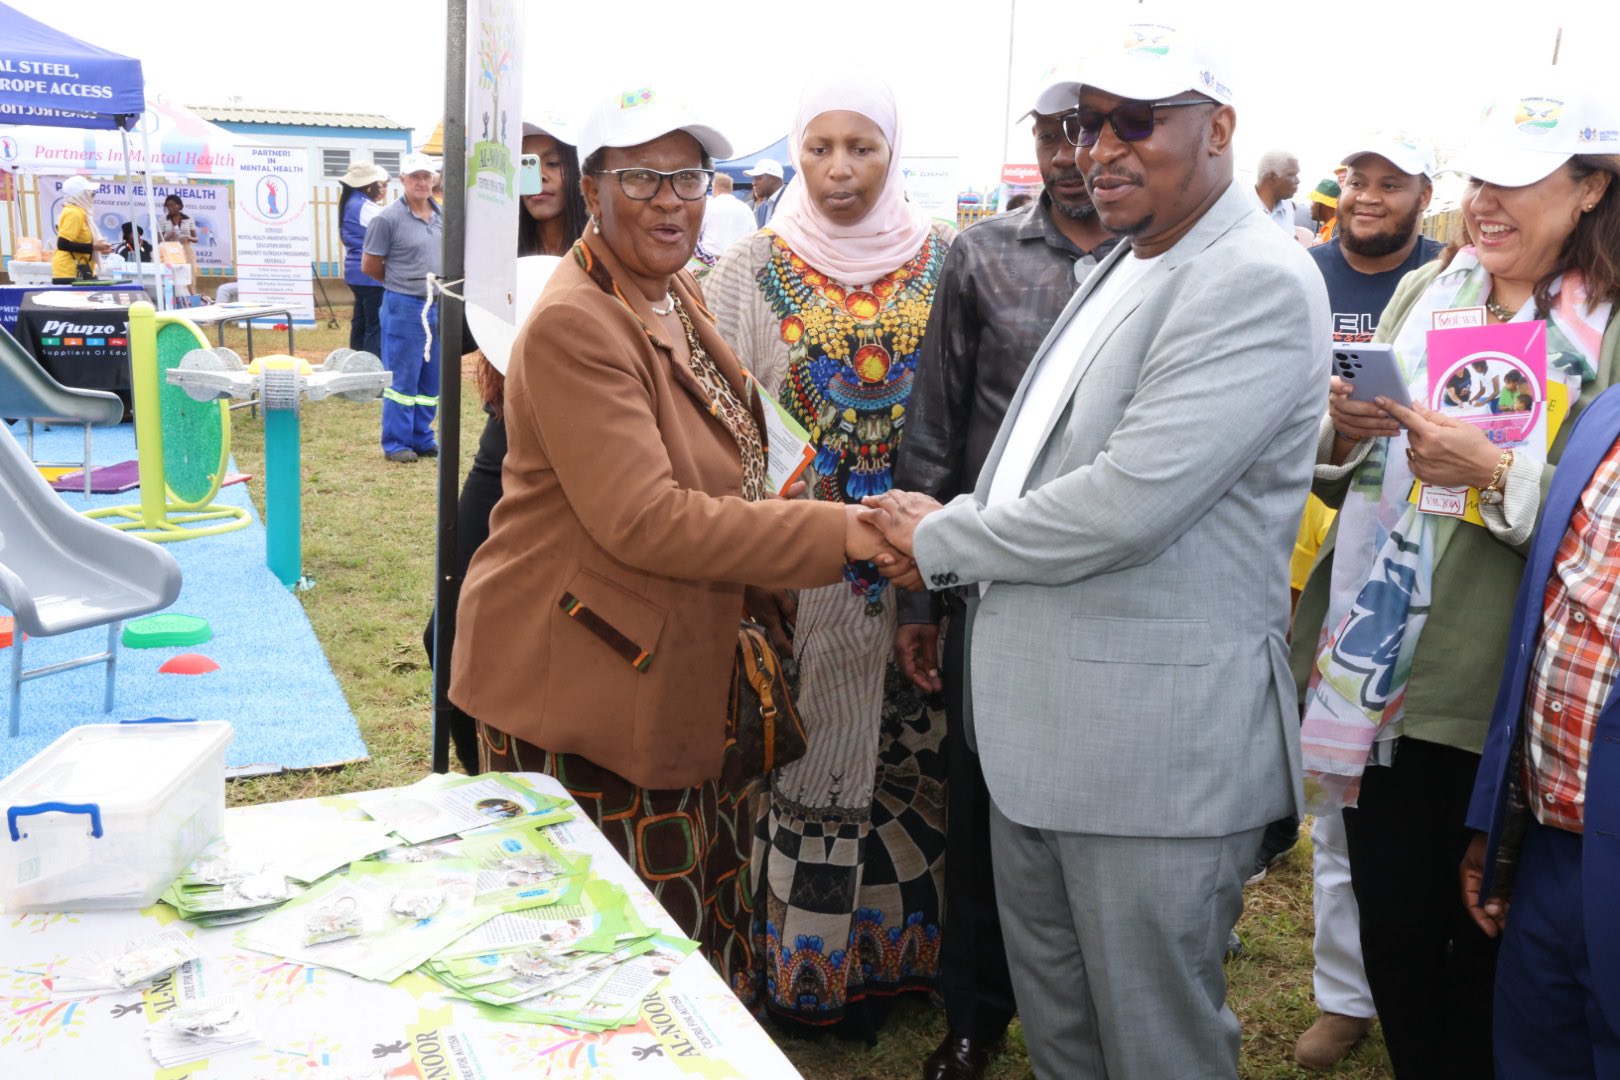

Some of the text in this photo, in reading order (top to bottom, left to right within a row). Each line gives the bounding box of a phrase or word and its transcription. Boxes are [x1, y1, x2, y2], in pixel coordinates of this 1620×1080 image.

[19, 60, 80, 79] STEEL,
[0, 79, 113, 98] ROPE ACCESS
[35, 145, 234, 167] Partners In Mntal Health
[252, 149, 291, 157] PARTNERS
[114, 185, 126, 195] IN
[174, 188, 216, 199] HEALTH
[42, 320, 115, 335] Pfunzo
[668, 995, 690, 1015] AUTISM
[683, 1015, 699, 1027] FOR
